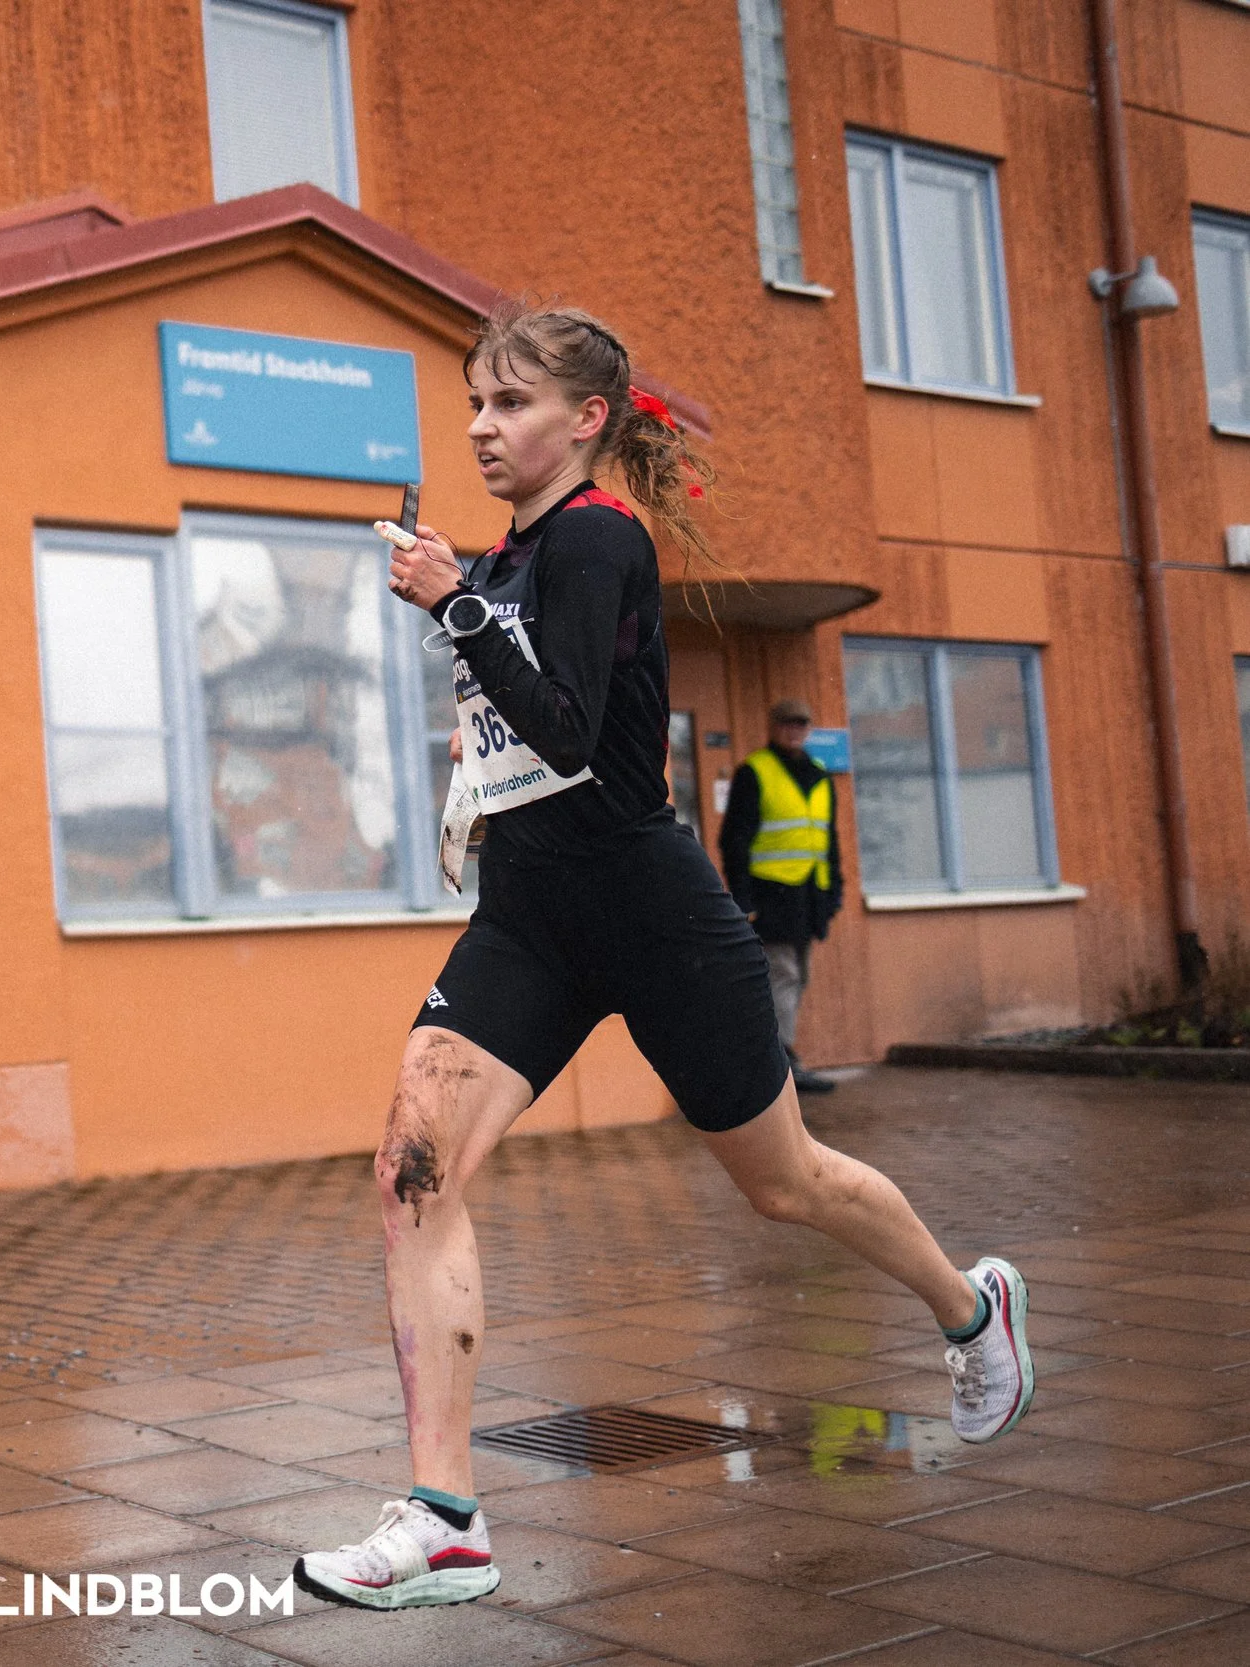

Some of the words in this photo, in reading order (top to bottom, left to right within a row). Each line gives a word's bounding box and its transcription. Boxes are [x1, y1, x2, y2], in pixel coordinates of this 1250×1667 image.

[264, 352, 372, 388] Stockholm
[471, 705, 525, 759] 36
[482, 768, 547, 799] Victoriahem
[426, 984, 449, 1009] TEX
